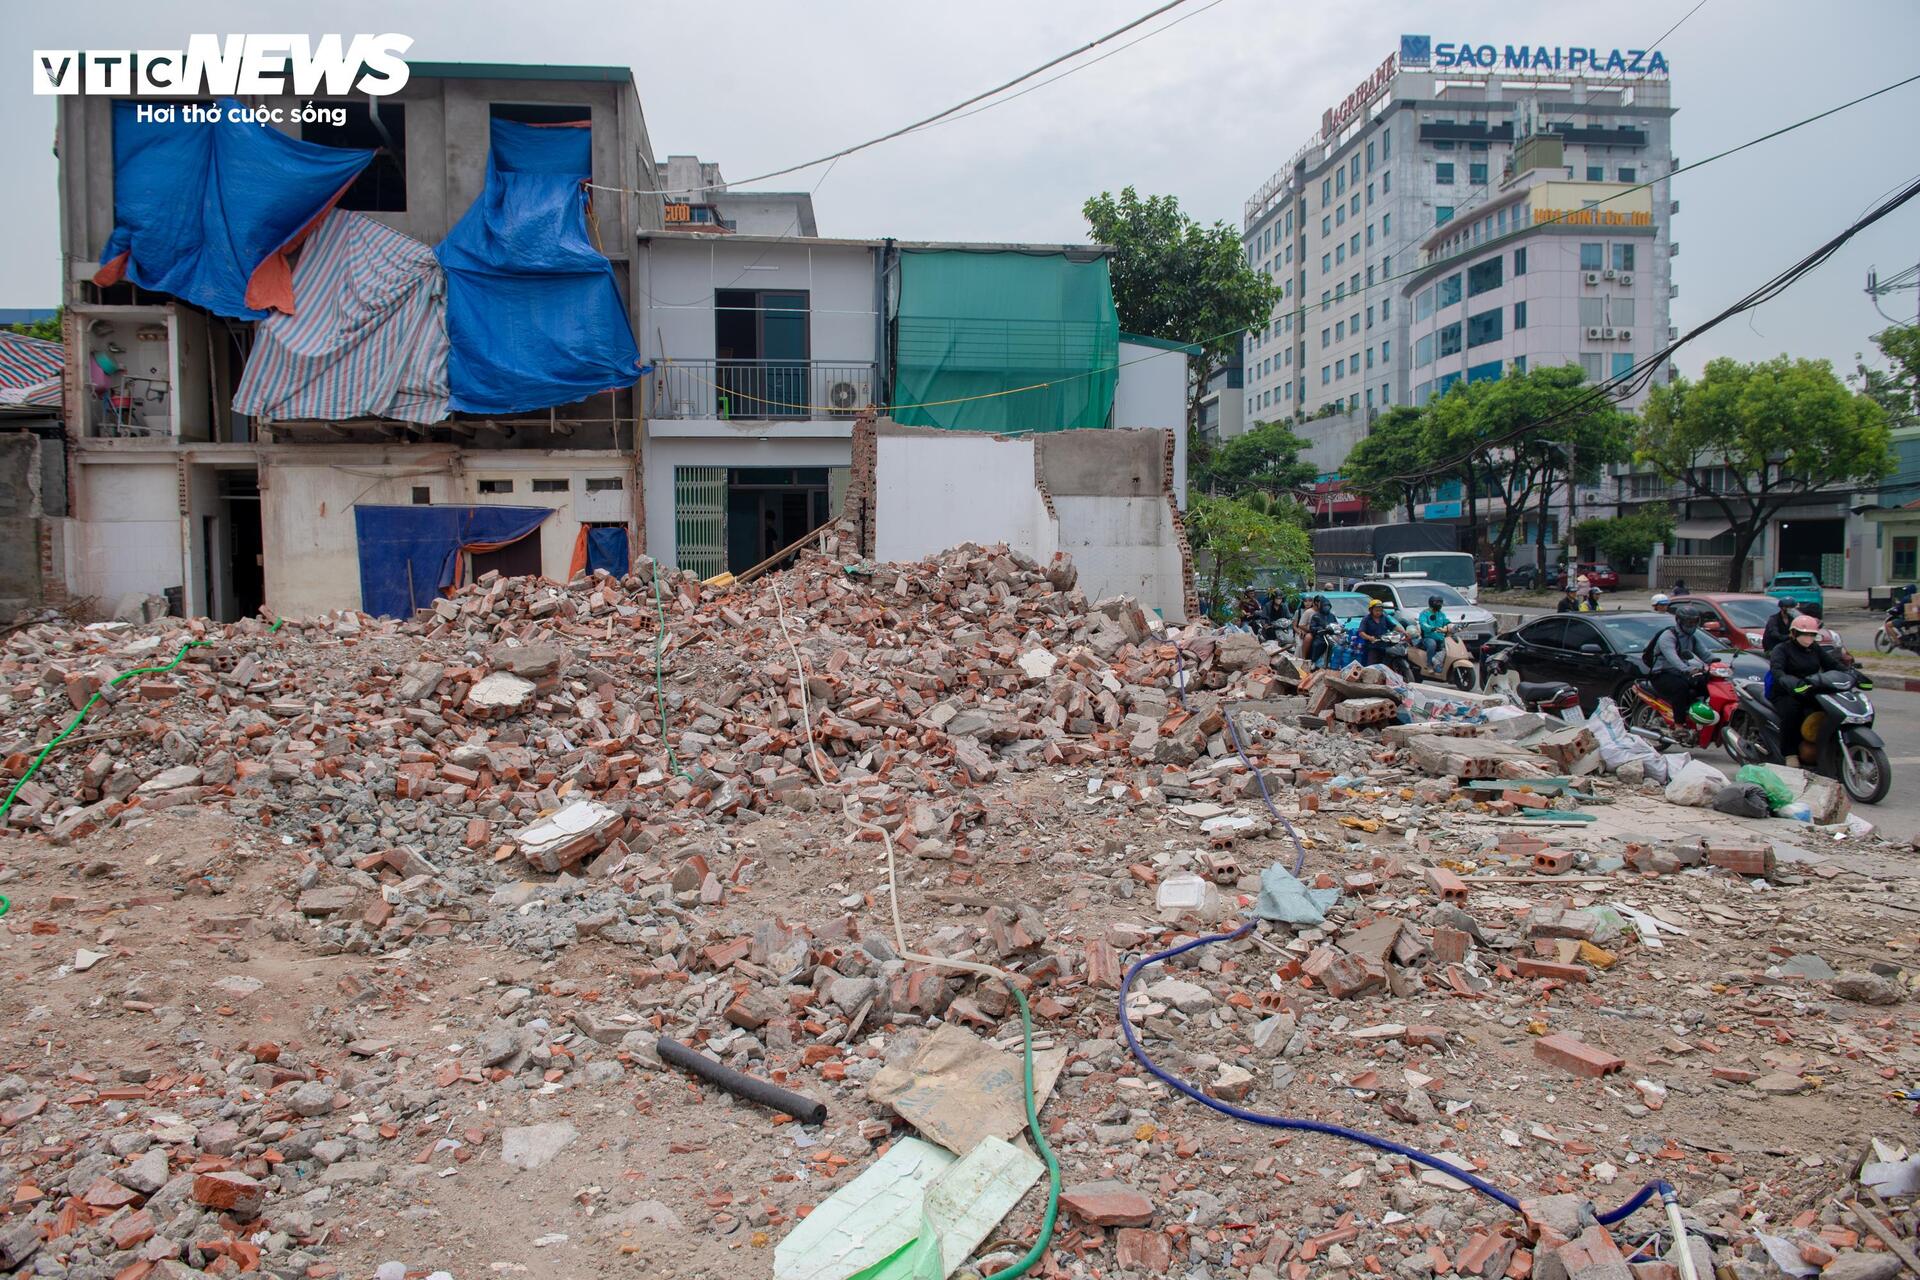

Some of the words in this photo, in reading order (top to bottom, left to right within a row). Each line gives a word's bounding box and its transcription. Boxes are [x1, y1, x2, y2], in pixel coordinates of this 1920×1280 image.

[1435, 43, 1497, 67] SAO
[1505, 45, 1561, 70] MAI
[1568, 47, 1669, 73] PLAZA
